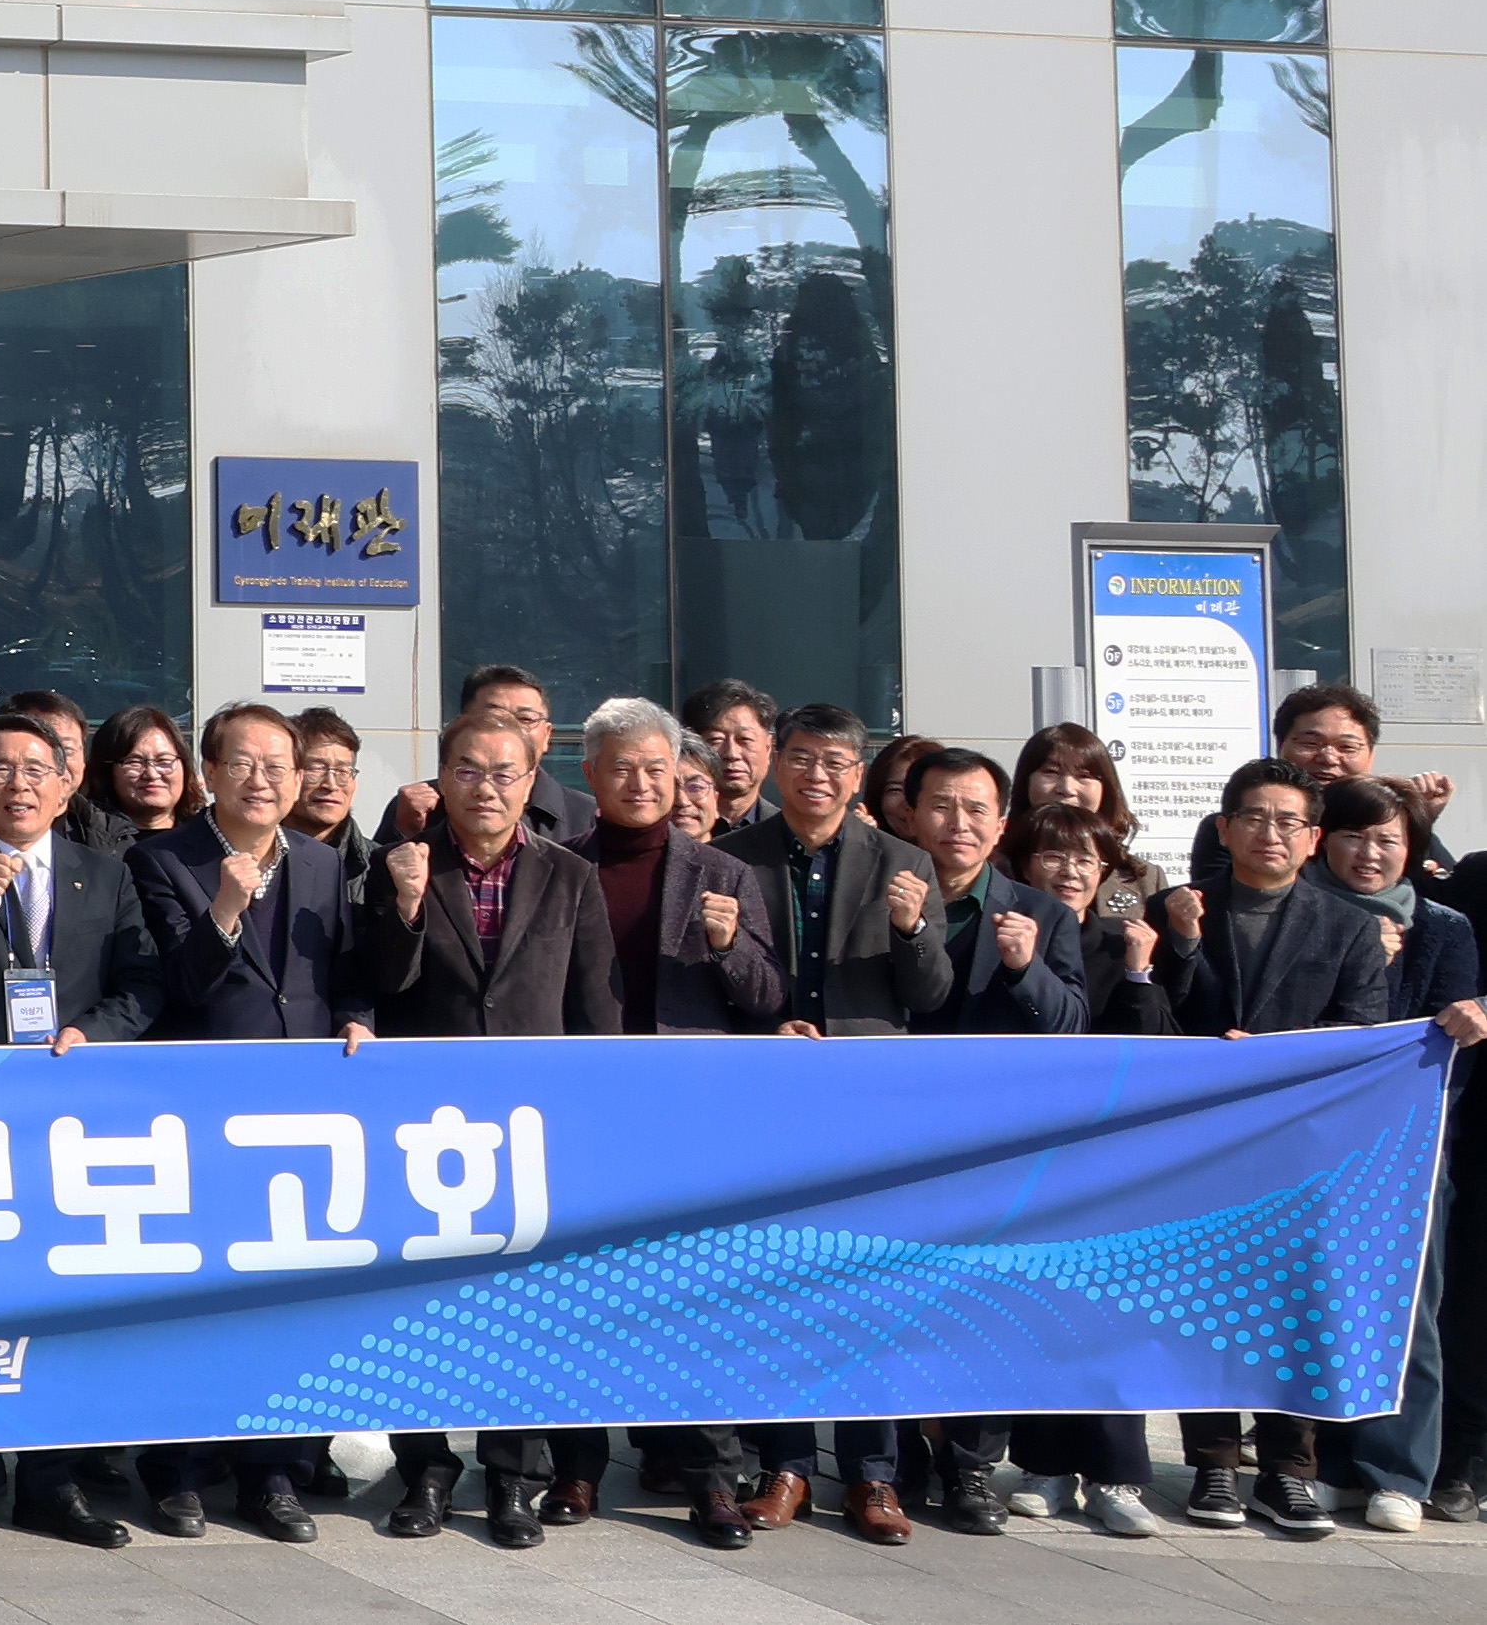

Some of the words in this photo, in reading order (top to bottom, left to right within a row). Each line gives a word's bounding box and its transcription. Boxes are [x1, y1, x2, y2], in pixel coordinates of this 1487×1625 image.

[234, 575, 287, 587] Gyeonggi-do
[290, 576, 321, 587] Training
[324, 577, 355, 587] Institute
[358, 578, 367, 587] of
[369, 578, 408, 588] Education
[1130, 578, 1241, 596] INFORMATION
[1105, 647, 1121, 664] 6F
[1107, 695, 1123, 710] 5F
[1109, 743, 1125, 758] 4F
